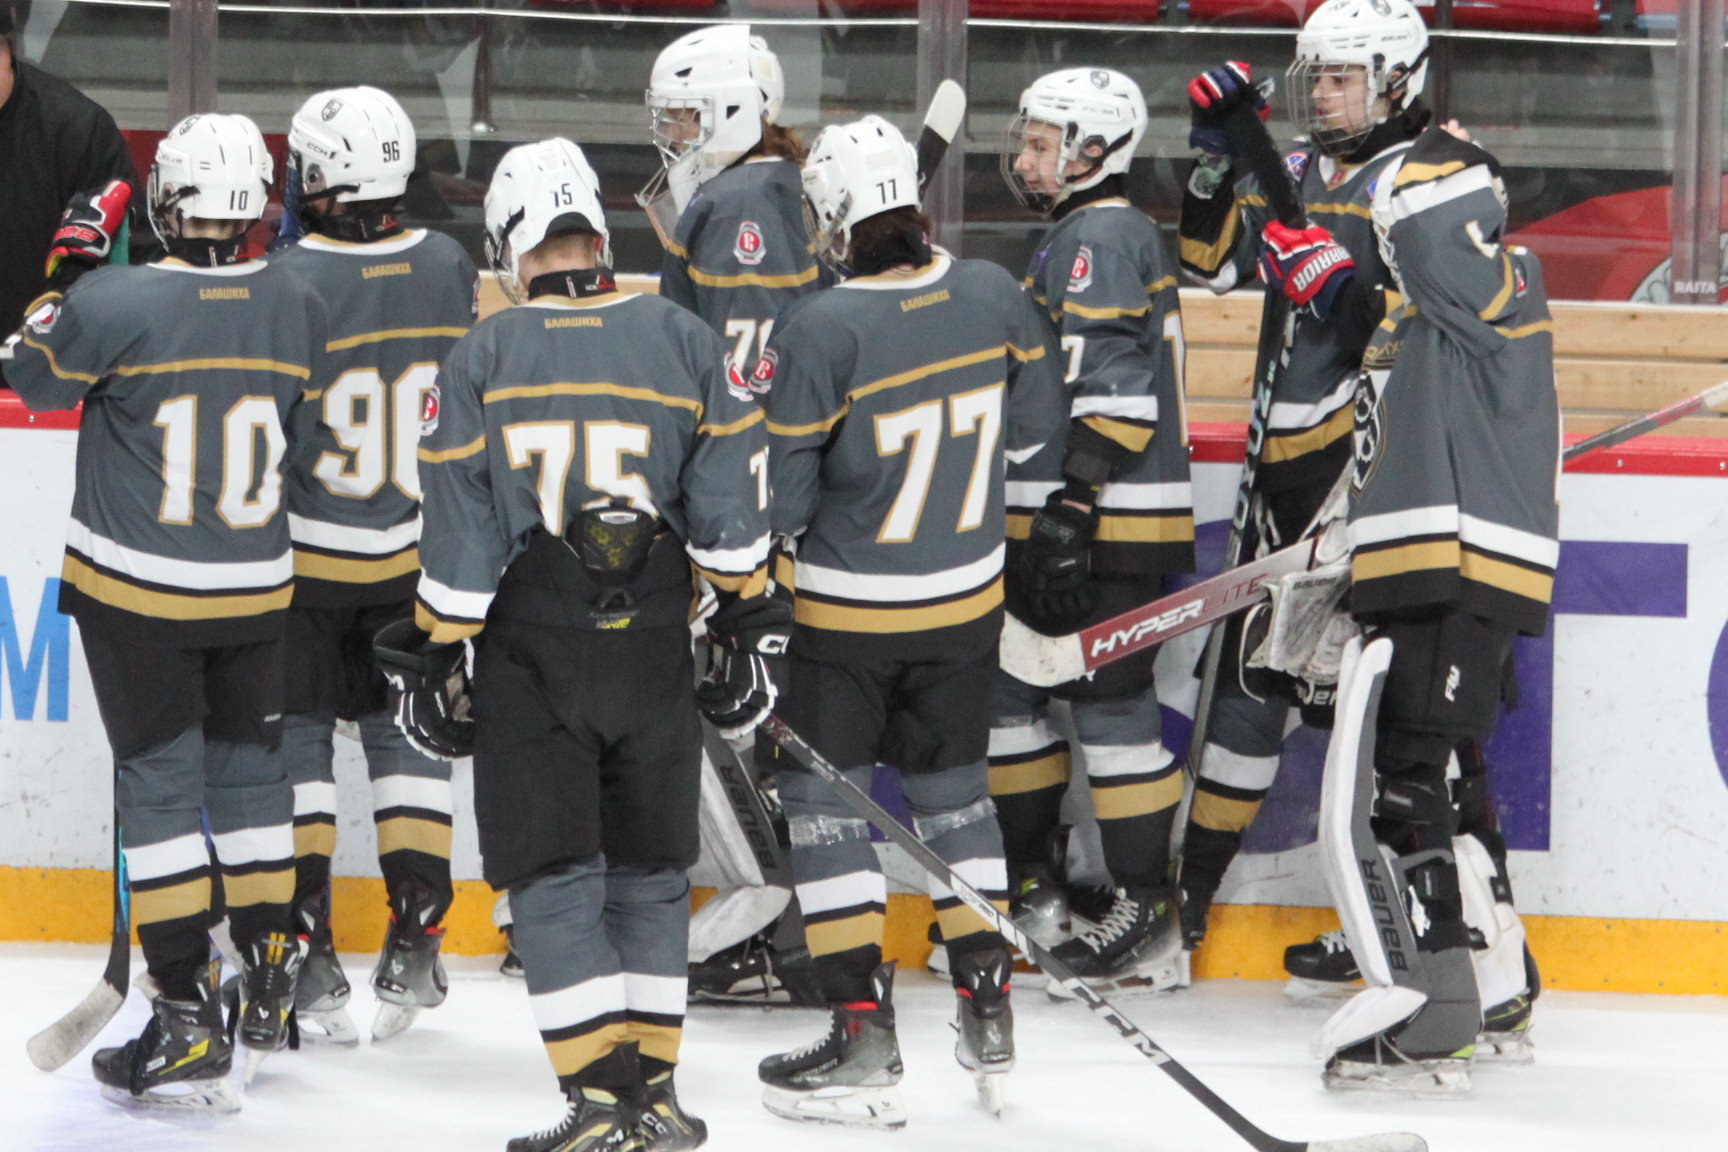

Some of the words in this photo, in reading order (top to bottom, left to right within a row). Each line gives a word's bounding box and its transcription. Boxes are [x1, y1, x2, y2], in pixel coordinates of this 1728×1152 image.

[381, 140, 400, 163] 96
[229, 190, 249, 211] 10
[361, 262, 412, 280] БАЛАШИХА
[199, 288, 250, 301] БАЛАШИХА
[1674, 281, 1718, 295] RAITA
[900, 289, 952, 314] БАЛАШИХА
[544, 316, 604, 330] БАЛАШИХА
[152, 394, 287, 528] 10
[872, 380, 1007, 545] 77
[501, 418, 664, 538] 75
[721, 764, 776, 869] BAUER
[1361, 858, 1409, 971] BAUER
[1061, 977, 1174, 1066] CCM
